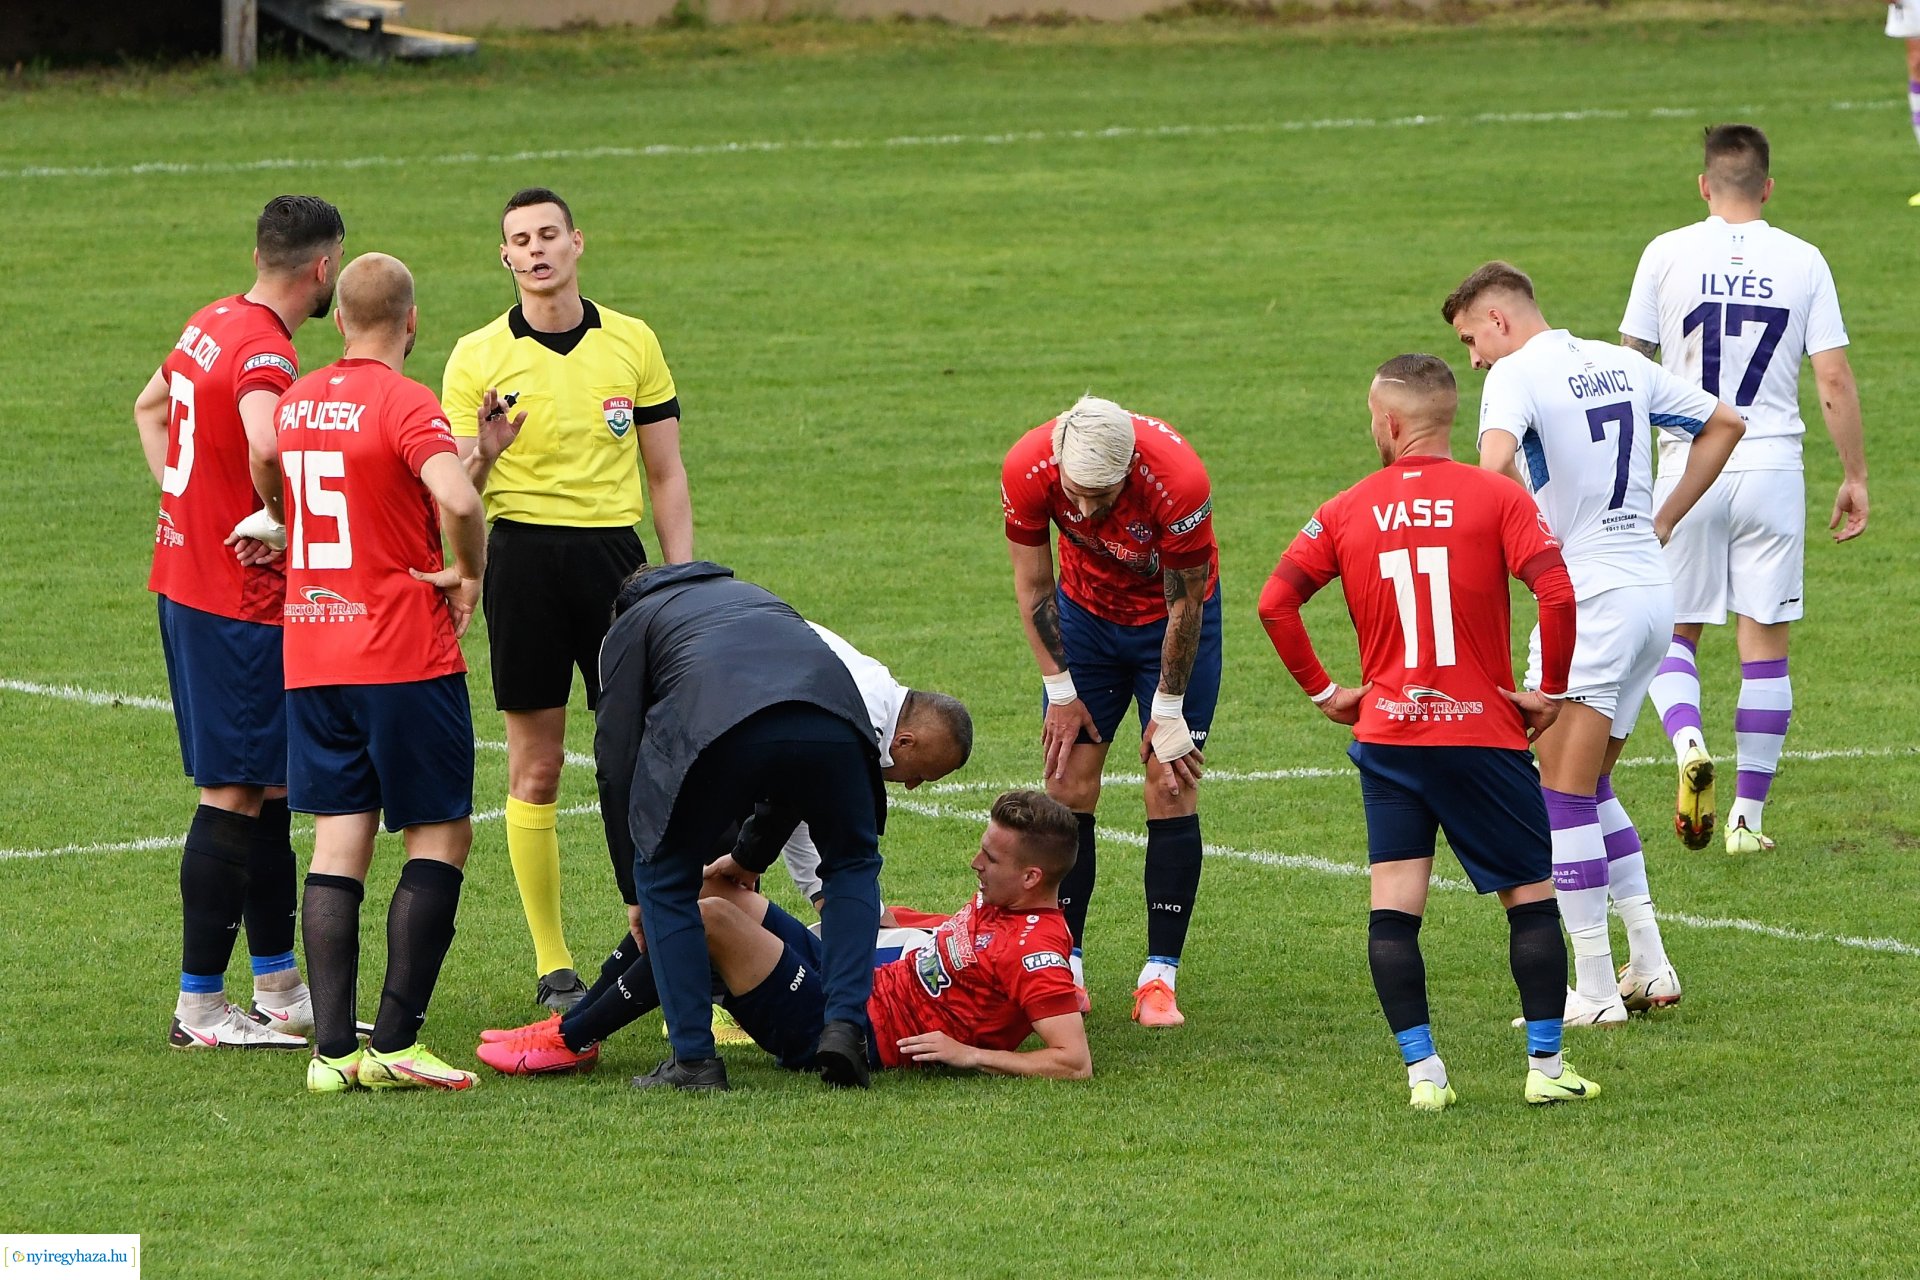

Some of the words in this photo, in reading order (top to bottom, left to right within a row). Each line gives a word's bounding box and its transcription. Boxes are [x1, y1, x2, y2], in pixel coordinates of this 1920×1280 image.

[1701, 269, 1773, 299] ILYÉS
[1682, 301, 1790, 407] 17
[279, 400, 366, 433] PAPUCSEK
[610, 400, 629, 408] MLSZ
[1585, 400, 1634, 511] 7
[281, 450, 352, 570] 15
[1372, 499, 1454, 532] VASS
[1378, 546, 1456, 669] 11
[1429, 701, 1484, 715] TRANS
[1151, 902, 1182, 913] JAKO
[790, 964, 806, 991] JAKO
